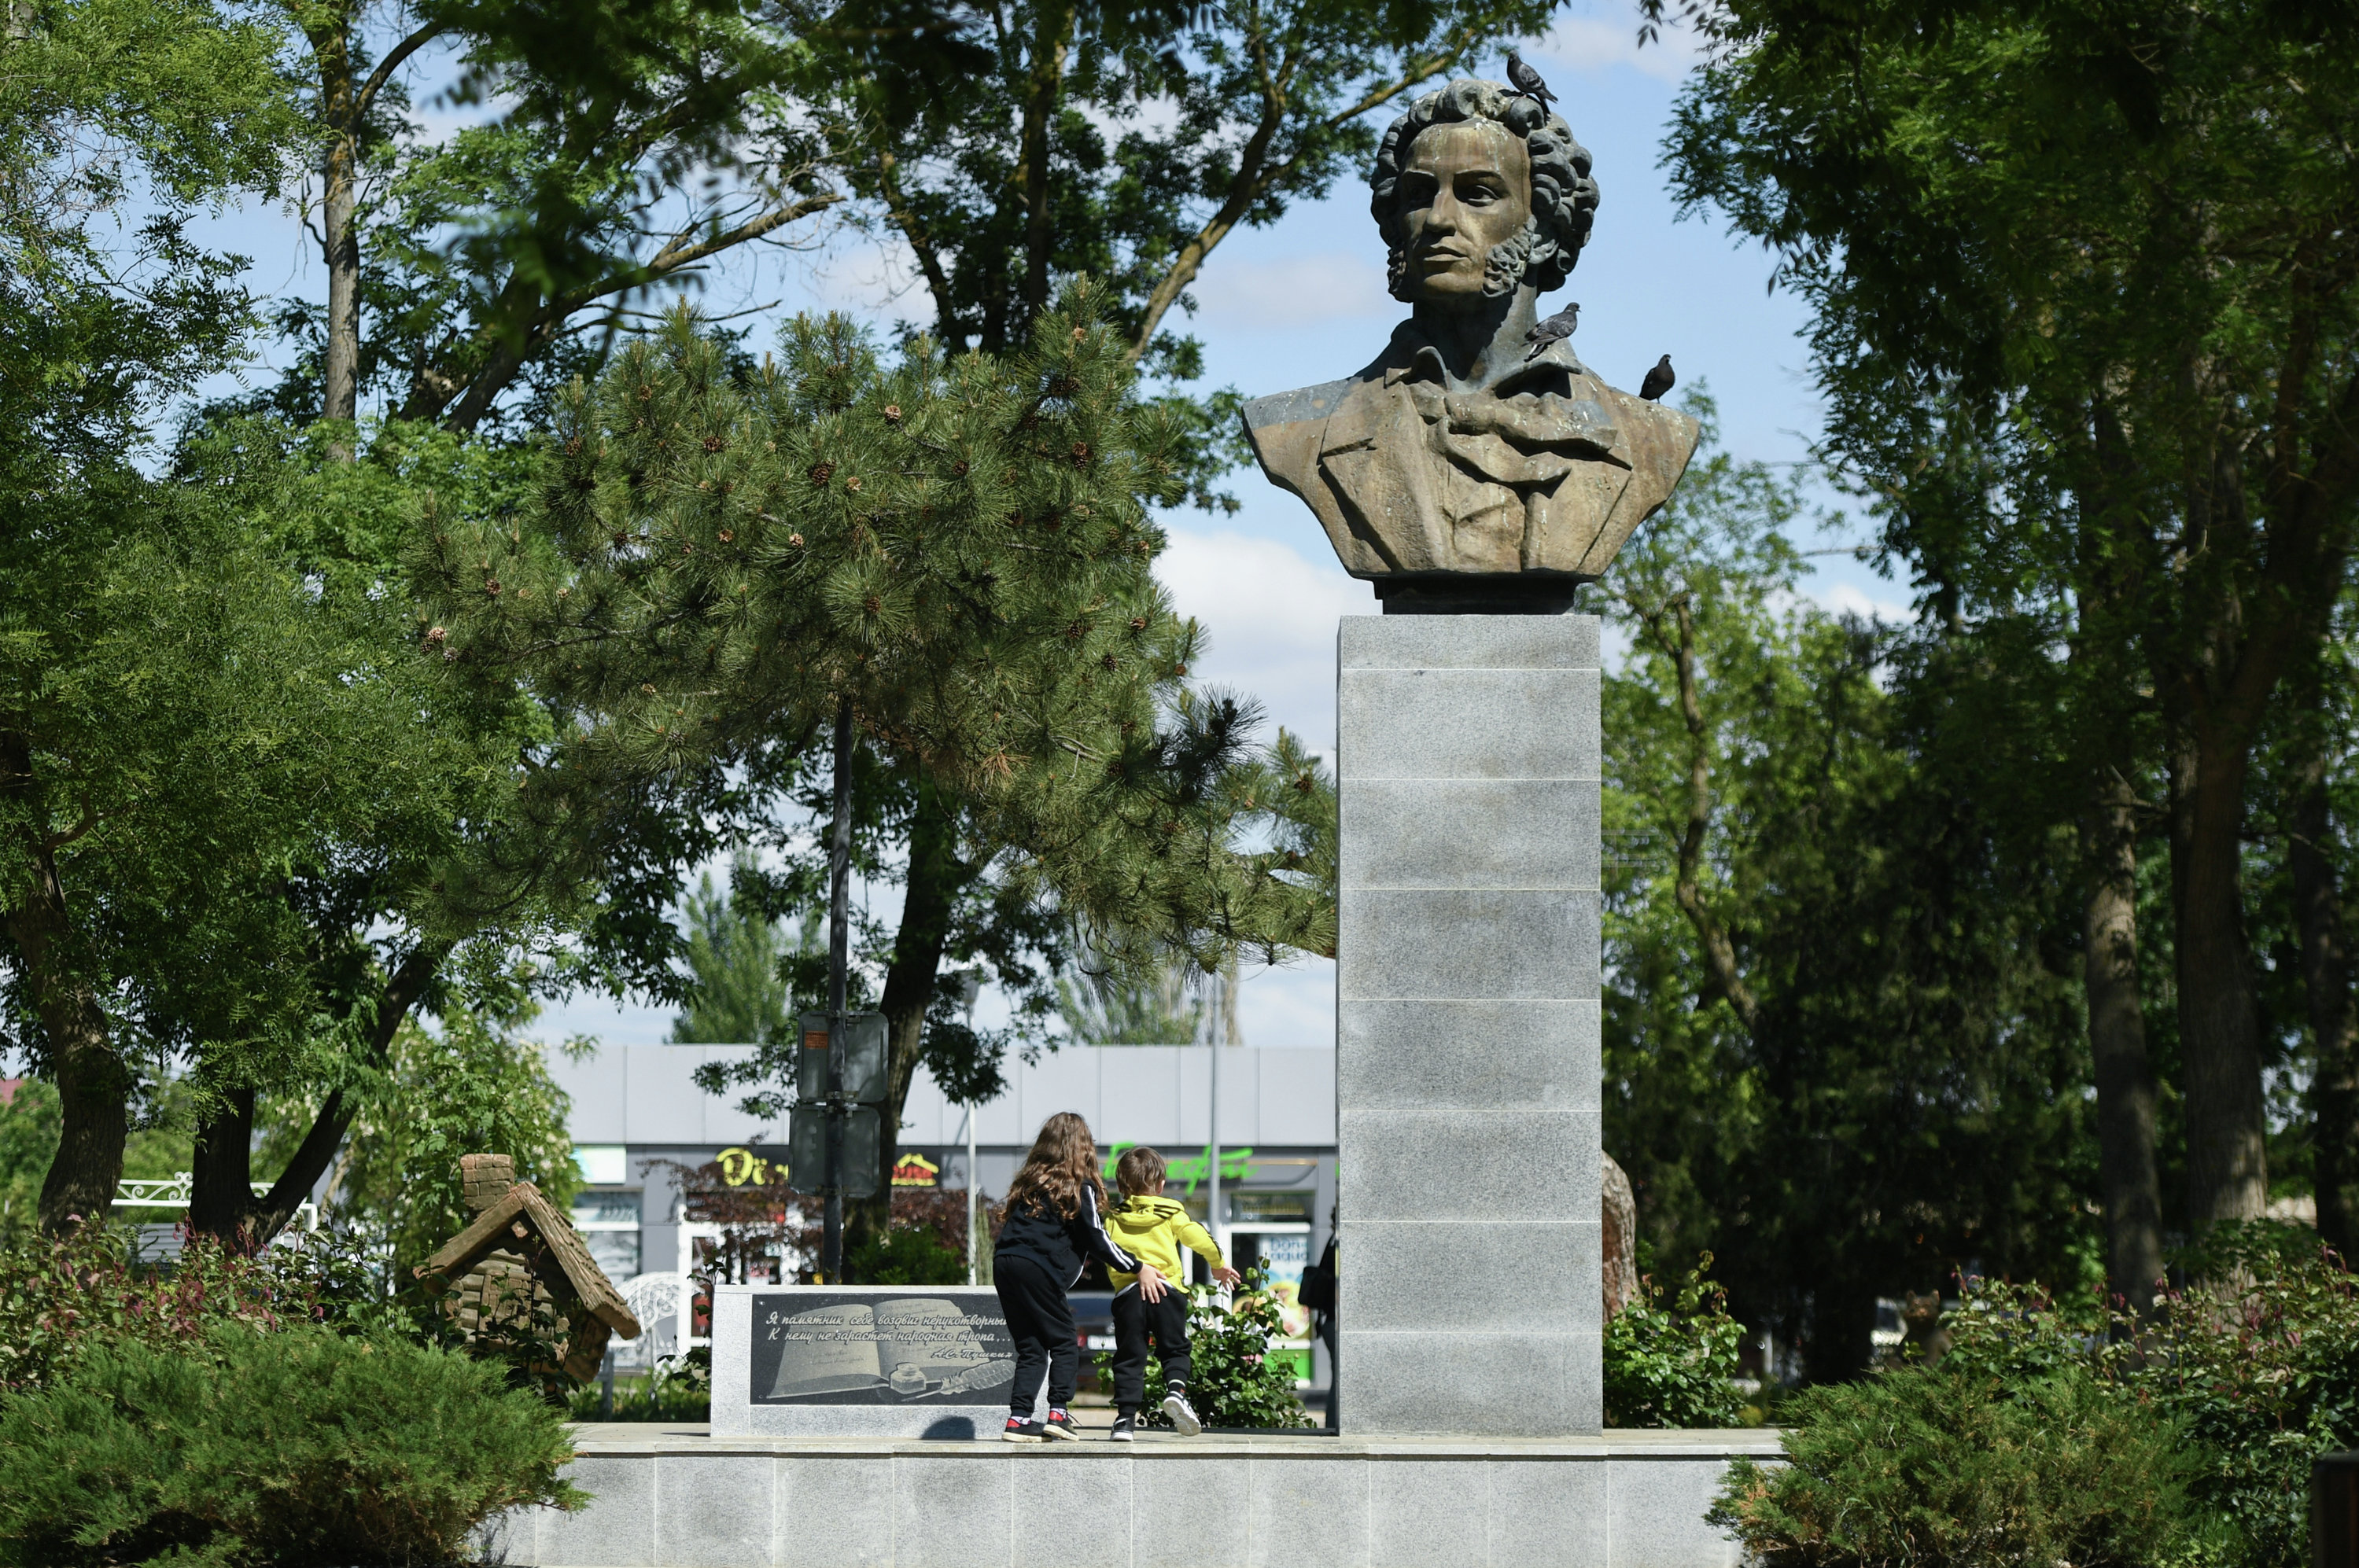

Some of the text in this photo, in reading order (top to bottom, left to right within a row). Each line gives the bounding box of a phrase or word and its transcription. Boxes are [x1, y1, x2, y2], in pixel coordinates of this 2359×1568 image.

[765, 1311, 778, 1325] Я
[781, 1314, 845, 1326] памятник
[850, 1312, 874, 1326] себе
[877, 1313, 919, 1329] воздвиг
[768, 1327, 781, 1341] К
[785, 1331, 812, 1345] нему
[817, 1331, 832, 1341] не
[834, 1330, 893, 1345] зарастет
[897, 1331, 954, 1345] народная
[960, 1350, 1012, 1360] Пушкин
